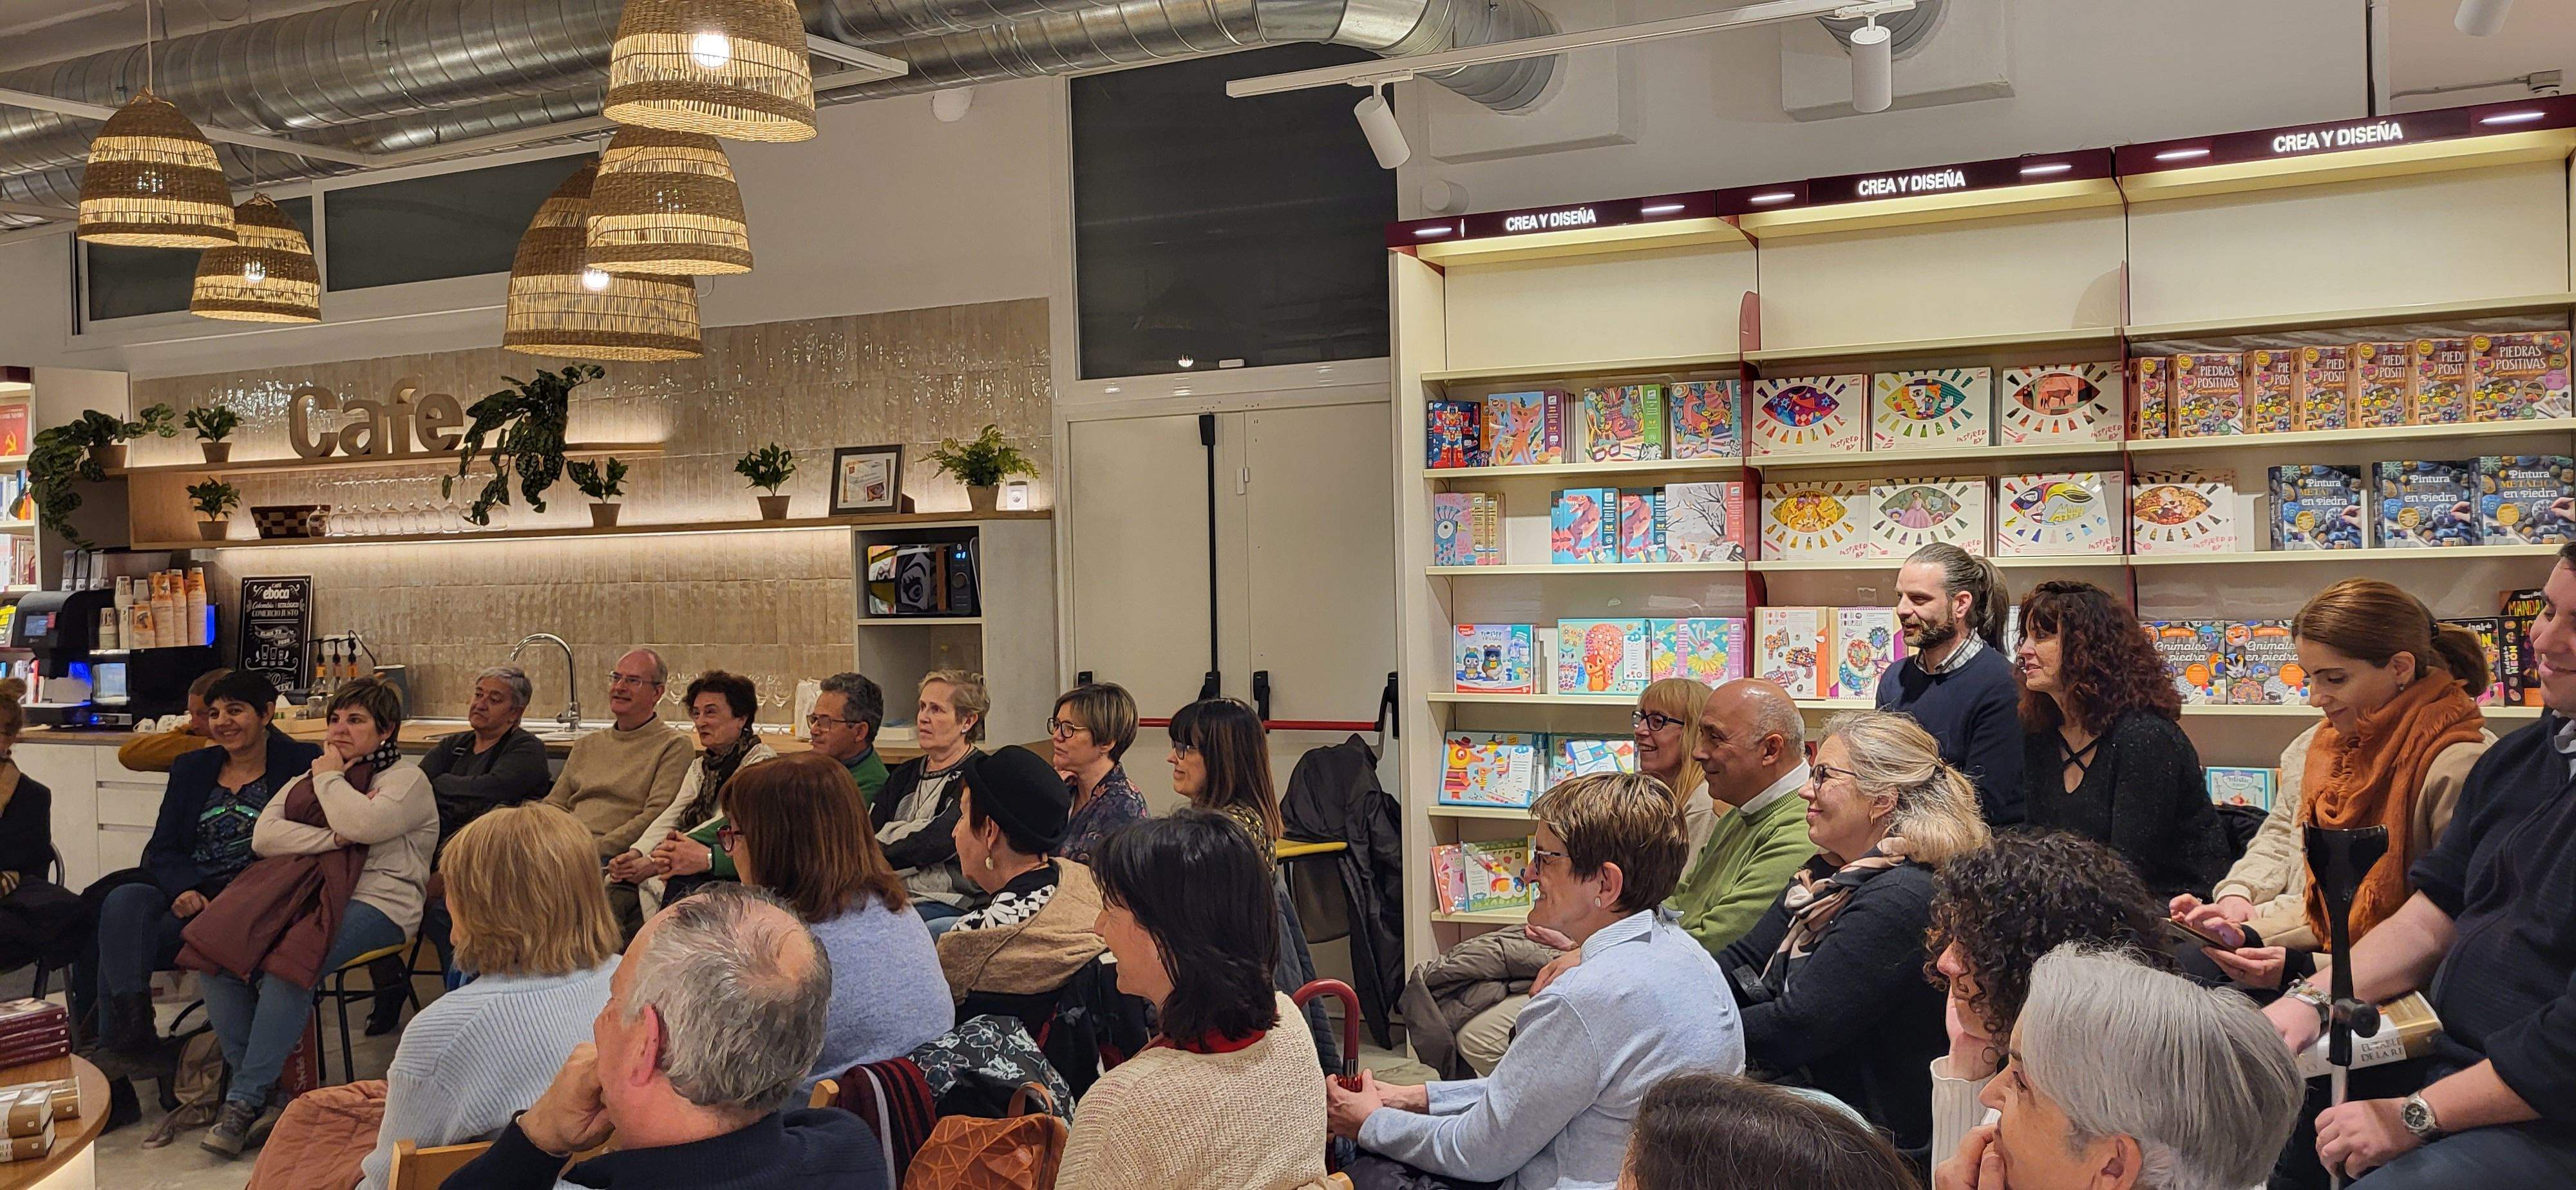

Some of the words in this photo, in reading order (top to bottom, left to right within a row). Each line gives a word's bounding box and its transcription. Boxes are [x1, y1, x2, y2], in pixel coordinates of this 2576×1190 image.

[2273, 132, 2320, 153] CREA
[2320, 130, 2334, 147] Y
[2337, 120, 2403, 146] DISEÑA
[1858, 177, 1897, 196] CREA
[1898, 176, 1909, 192] Y
[1911, 169, 1966, 191] DISEÑA
[1505, 214, 1539, 231] CREA
[1539, 213, 1549, 228] Y
[1549, 207, 1596, 227] DISEÑA
[2441, 351, 2465, 362] PIED
[2499, 345, 2542, 358] PIEDRAS
[2326, 359, 2345, 370] PIED
[2383, 354, 2405, 366] PIED
[2496, 358, 2546, 371] POSITIVAS
[2200, 365, 2235, 377] PIEDRAS
[2380, 366, 2405, 378] POSITI
[2438, 363, 2463, 375] POSIT
[2197, 377, 2240, 388] POSITIVAS
[2324, 371, 2346, 382] POSIT
[290, 377, 464, 460] Cafe
[1956, 429, 1987, 442] INSPIRED
[2091, 424, 2123, 438] INSPIRED
[1830, 435, 1859, 449] INSPIRED
[2409, 475, 2450, 484] Pintura
[2508, 469, 2550, 479] Pintura
[2306, 478, 2342, 487] Pintura
[2405, 493, 2419, 502] en
[2503, 490, 2519, 498] en
[2301, 498, 2315, 506] en
[2088, 536, 2121, 549] INSPIRED
[2193, 536, 2225, 549] INSPIRED
[1839, 543, 1868, 555] INSPIRED
[263, 587, 290, 600] eboca
[2508, 599, 2543, 617] MANDA
[2155, 641, 2209, 652] Animales
[2245, 641, 2297, 652] Animale
[2166, 652, 2208, 665] piedra
[2260, 651, 2299, 664] piedra
